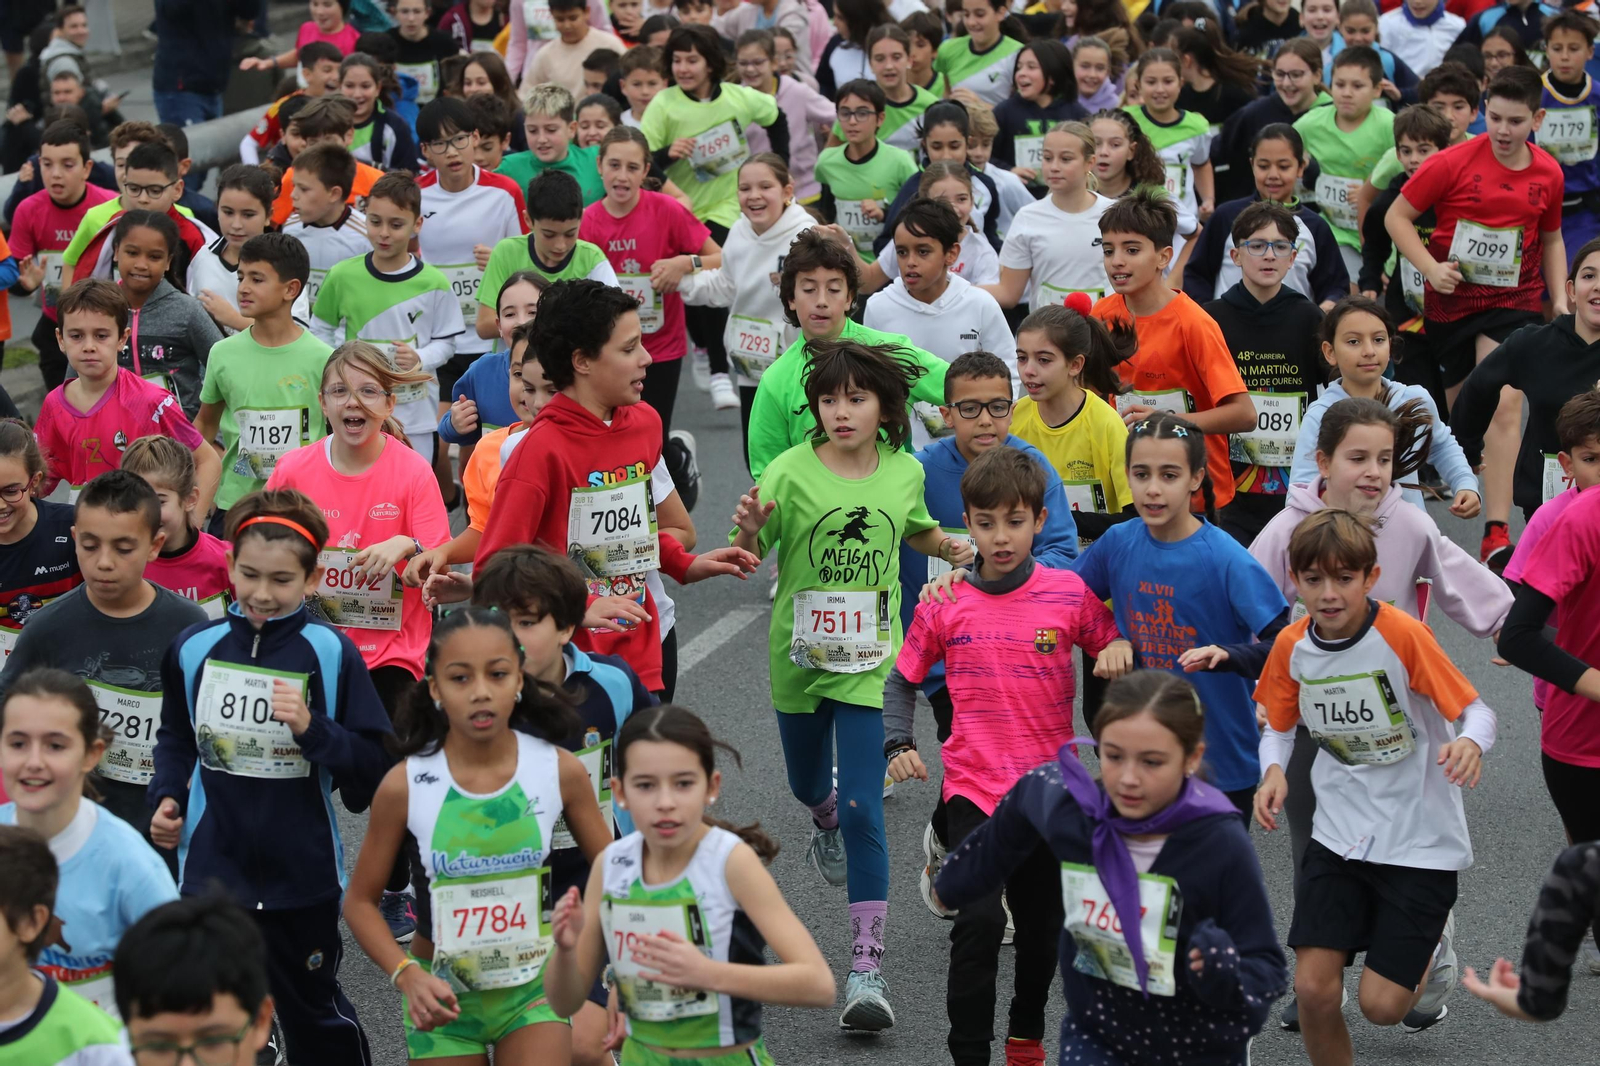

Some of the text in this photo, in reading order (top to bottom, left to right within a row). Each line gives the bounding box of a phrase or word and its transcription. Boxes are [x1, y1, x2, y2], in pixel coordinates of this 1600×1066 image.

[1549, 122, 1585, 138] 7179
[698, 134, 730, 158] 7699
[1325, 186, 1347, 203] 718
[608, 239, 637, 252] XLVI
[1467, 238, 1509, 259] 7099
[452, 279, 481, 297] 059
[740, 332, 771, 354] 7293
[1255, 353, 1286, 361] CARREIRA
[1145, 372, 1166, 380] court
[1250, 363, 1299, 376] MARTIÑO
[1259, 378, 1271, 387] DE
[1142, 398, 1157, 406] DIEGO
[1263, 399, 1280, 408] PABLO
[259, 413, 276, 421] MATEO
[1258, 411, 1293, 432] 089
[249, 425, 293, 445] 7187
[588, 461, 646, 488] SUPER
[574, 496, 586, 504] SUB
[610, 492, 624, 502] HUGO
[591, 504, 642, 536] 7084
[634, 545, 655, 555] XLVIII
[49, 561, 70, 573] mupol
[1138, 581, 1174, 598] XLVII
[826, 596, 846, 604] IRIMIA
[811, 609, 861, 634] 7511
[359, 644, 378, 652] MUJER
[945, 635, 973, 648] BARÇA
[857, 650, 883, 659] XLVIII
[1141, 655, 1174, 670] 2024
[211, 671, 230, 681] SUB 12
[245, 677, 268, 689] MARTÍN
[1323, 686, 1347, 696] MARTÍN
[116, 697, 141, 709] MARCO
[1314, 699, 1374, 725] 7466
[98, 708, 153, 741] 7281
[1374, 733, 1403, 747] XLVIII
[107, 759, 133, 768] OURENSE
[140, 758, 154, 768] XL
[432, 850, 543, 877] Natursueño
[470, 887, 506, 898] REISHELL
[453, 902, 527, 938] 7784
[628, 912, 646, 922] SARA
[517, 948, 547, 962] XLVIII
